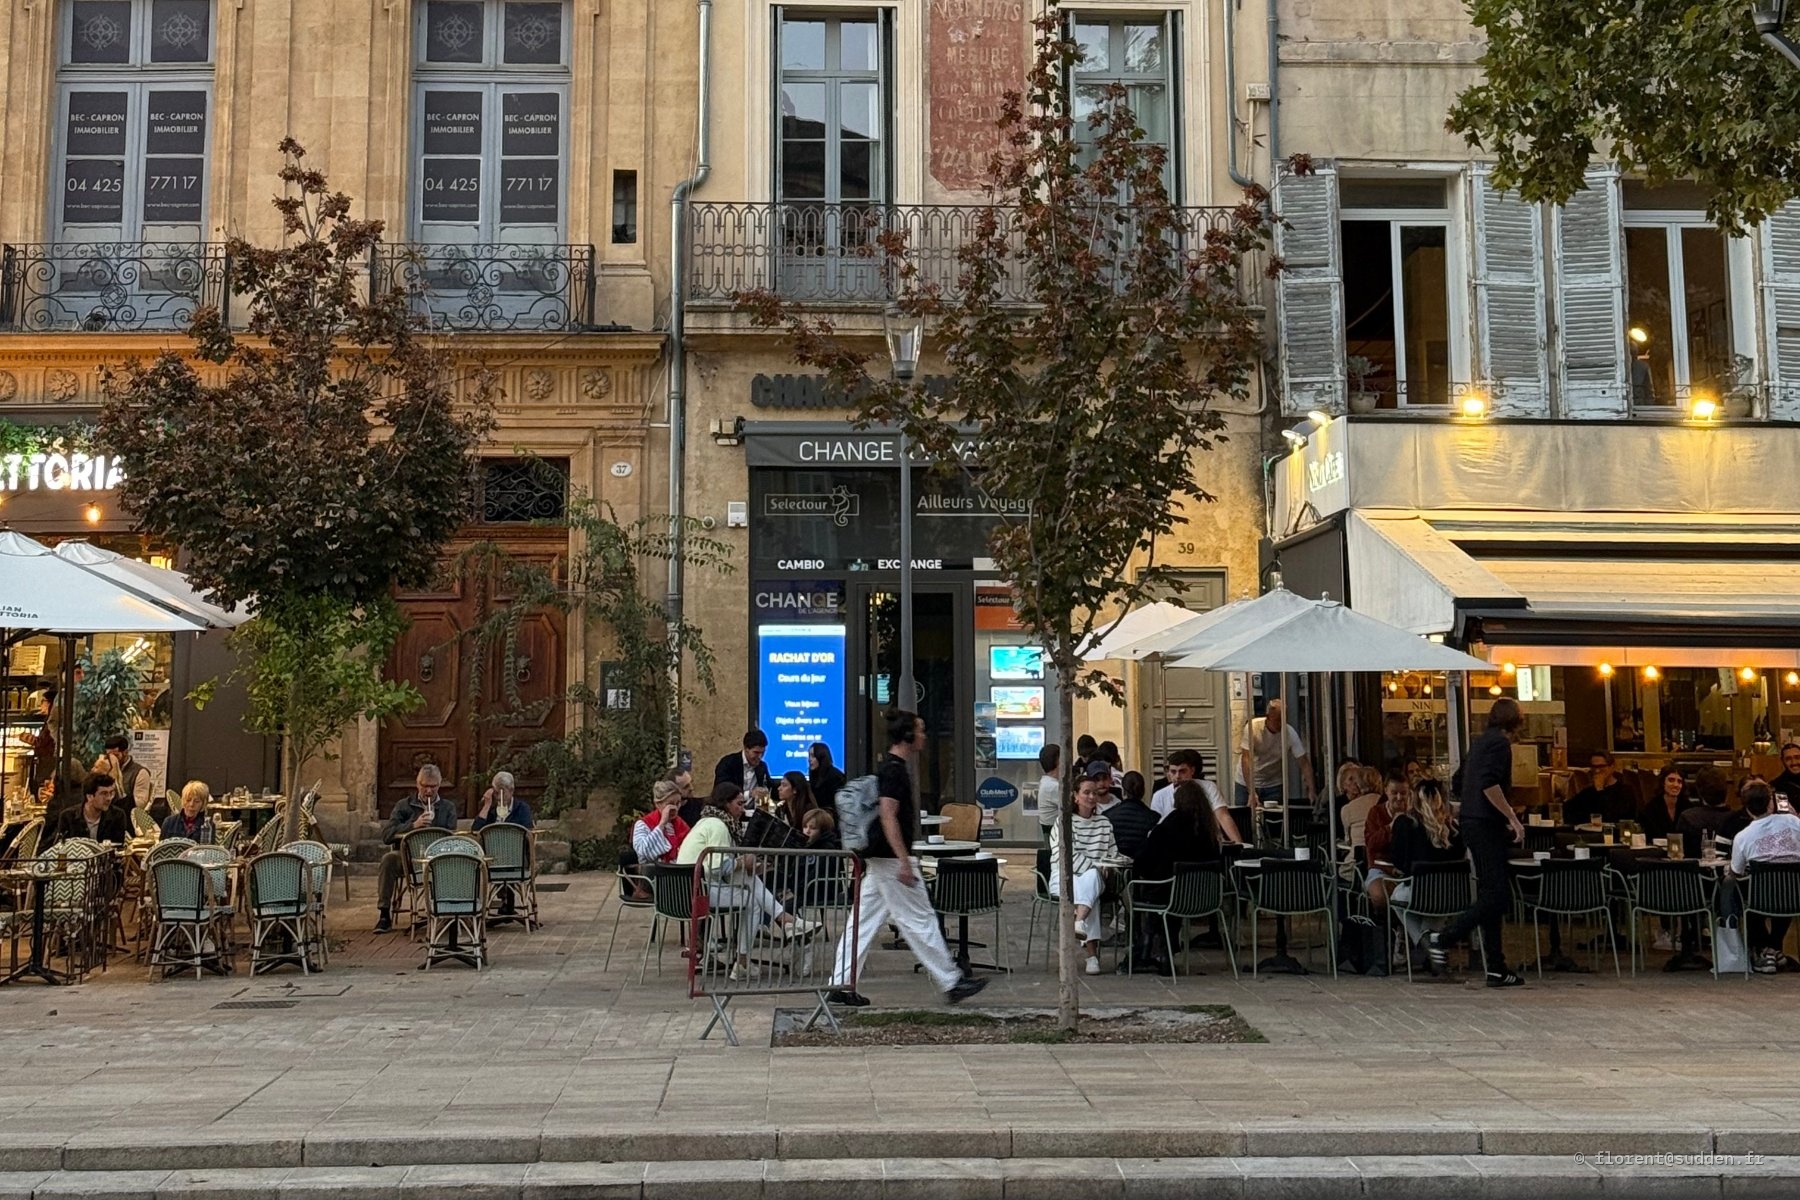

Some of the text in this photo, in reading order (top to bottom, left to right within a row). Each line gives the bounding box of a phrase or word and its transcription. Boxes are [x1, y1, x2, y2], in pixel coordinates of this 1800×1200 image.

[90, 113, 125, 121] CAPRON
[169, 112, 204, 120] CAPRON
[446, 113, 480, 121] CAPRON
[523, 114, 557, 122] CAPRON
[74, 126, 120, 134] IMMOBILIER
[153, 125, 199, 133] IMMOBILIER
[430, 126, 475, 134] IMMOBILIER
[508, 126, 552, 134] IMMOBILIER
[67, 177, 122, 192] 04 425
[150, 176, 198, 190] 771 17
[424, 177, 478, 191] 04 425
[506, 177, 553, 191] 771 17
[799, 441, 894, 461] CHANGE
[0, 453, 127, 490] TTORIA
[616, 464, 628, 474] 37
[770, 498, 828, 510] Selectour
[917, 494, 1036, 512] Ailleurs Voyage
[1177, 542, 1195, 555] 39
[777, 559, 825, 570] CAMBIO
[877, 559, 943, 570] EXCANGE
[755, 592, 838, 609] CHANGE
[977, 595, 1011, 604] Selectour
[769, 652, 835, 664] RACHAT D'OR
